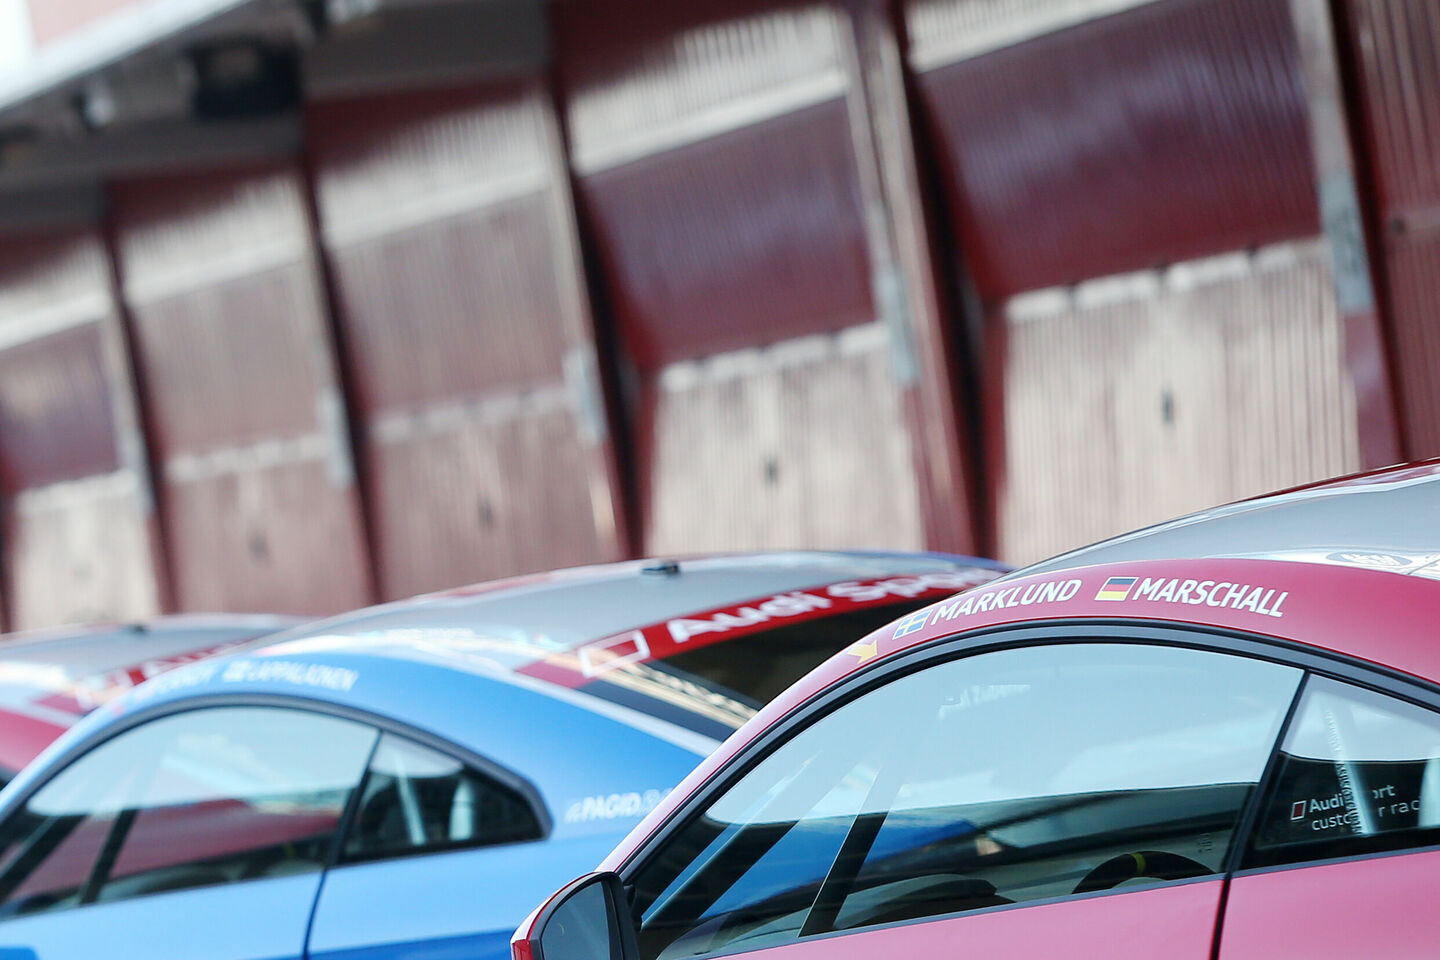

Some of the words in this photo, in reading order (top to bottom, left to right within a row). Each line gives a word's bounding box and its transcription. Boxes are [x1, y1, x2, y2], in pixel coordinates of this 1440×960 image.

[667, 591, 832, 643] Audi
[930, 579, 1083, 626] MARKLUND
[1133, 577, 1290, 618] MARSCHALL
[1310, 793, 1345, 812] Audi
